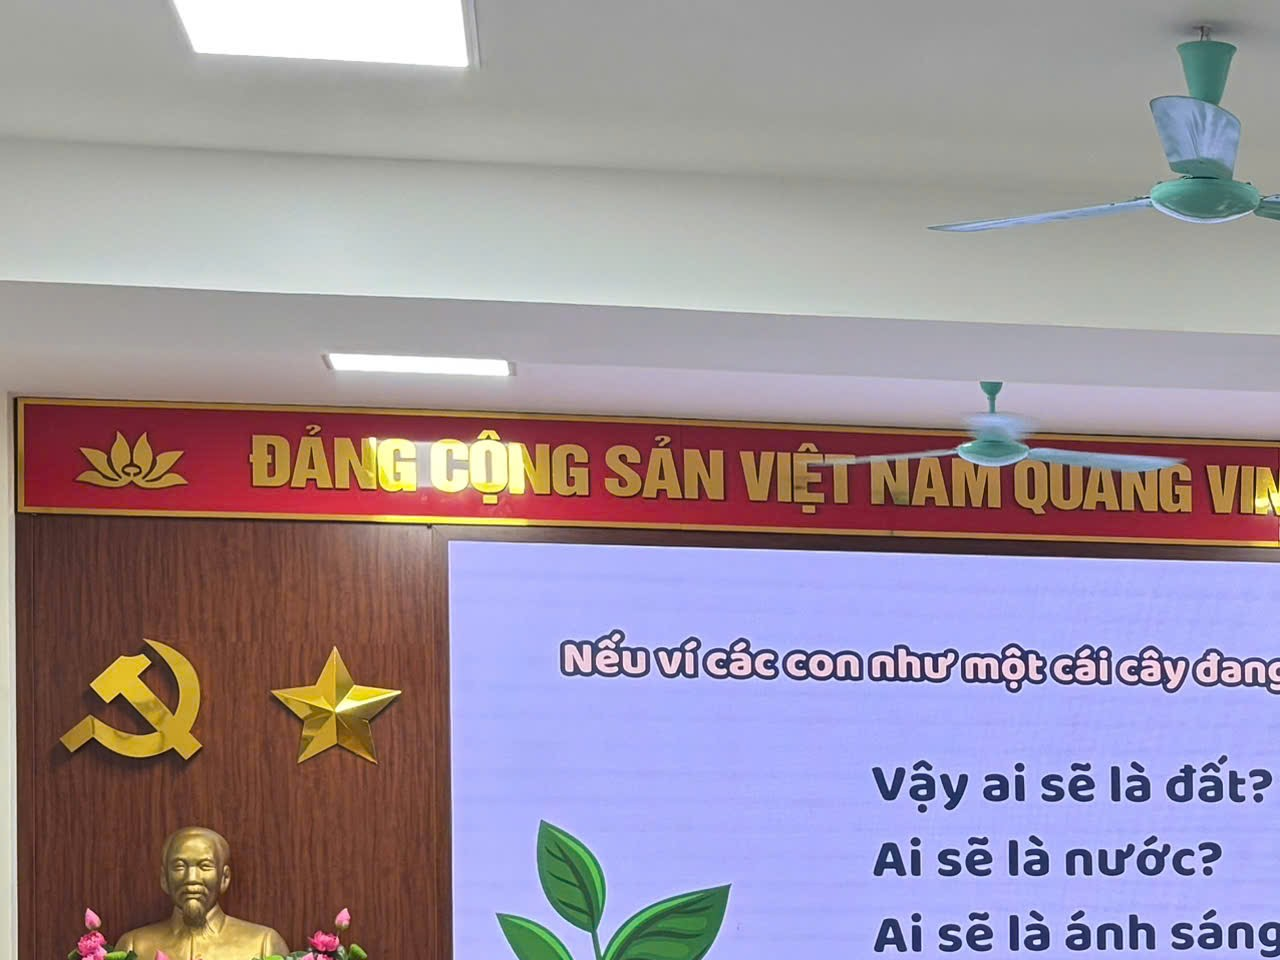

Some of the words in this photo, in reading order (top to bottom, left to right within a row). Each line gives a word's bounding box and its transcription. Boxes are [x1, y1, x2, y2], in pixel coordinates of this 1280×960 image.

[249, 424, 417, 492] ĐẢNG
[430, 429, 590, 505] CỘNG
[603, 435, 725, 501] SẢN
[739, 442, 856, 514] VIỆT
[870, 456, 1001, 508] NAM
[1013, 459, 1193, 515] QUANG
[559, 629, 651, 677] Nếu
[653, 636, 700, 678] ví
[702, 637, 779, 681] các
[783, 649, 864, 682] con
[867, 644, 960, 683] như
[961, 643, 1047, 693] một
[1049, 644, 1112, 685] cái
[1113, 645, 1189, 693] cây
[872, 760, 969, 814] Vậy
[982, 762, 1026, 802] ai
[1040, 762, 1096, 802] sẽ
[1110, 761, 1152, 803] là
[1165, 754, 1273, 804] đất?
[873, 837, 922, 877] Ai
[937, 836, 994, 877] sẽ
[1008, 835, 1050, 877] là
[1065, 835, 1223, 877] nước?
[873, 912, 922, 953] Ai
[938, 911, 994, 953] sẽ
[1009, 910, 1051, 952] là
[1065, 910, 1157, 952] ánh
